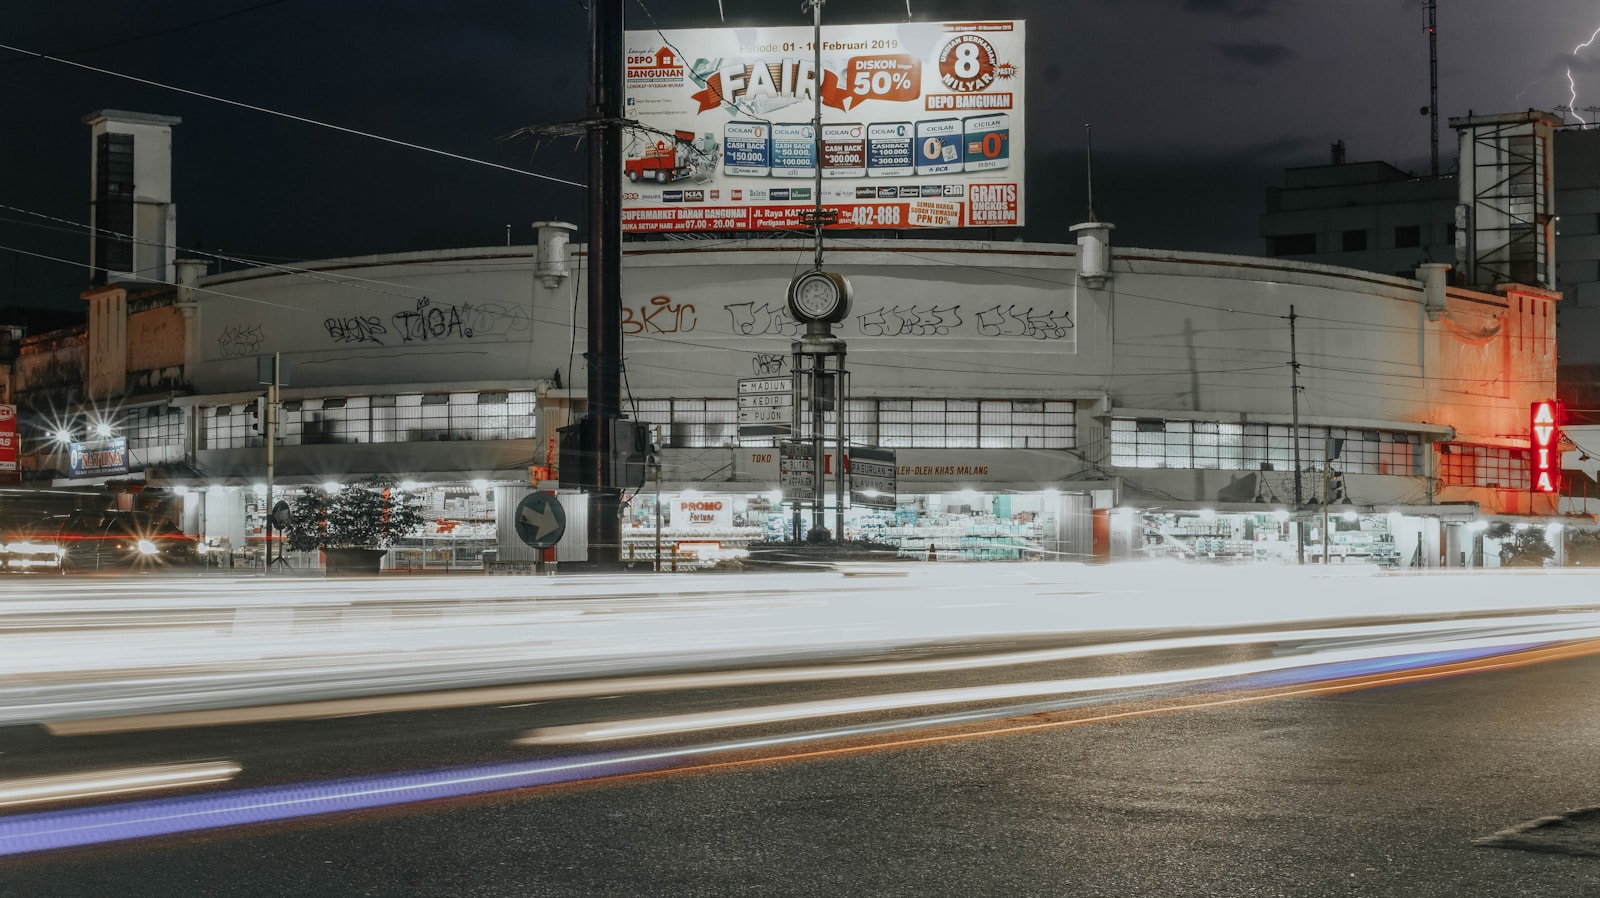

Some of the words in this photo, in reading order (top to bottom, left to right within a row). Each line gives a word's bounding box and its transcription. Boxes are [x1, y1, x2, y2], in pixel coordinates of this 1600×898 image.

[783, 42, 795, 51] 01
[822, 40, 868, 51] Februari
[872, 39, 898, 49] 2019
[627, 56, 653, 64] DEPO
[856, 60, 897, 70] DISKON
[955, 42, 981, 79] 8
[627, 69, 684, 78] BANGUNAN
[719, 57, 825, 107] FAIR
[853, 71, 911, 96] 50%
[943, 73, 993, 92] MILYAR
[928, 96, 954, 109] DEPO
[955, 94, 1010, 109] BANGUNAN
[973, 120, 1001, 128] CICILAN
[727, 142, 746, 150] CASH
[970, 185, 1016, 203] GRATIS
[916, 201, 934, 209] SEMUA
[935, 203, 954, 211] HARGA
[972, 202, 1008, 211] ONGKOS
[622, 210, 676, 220] SUPERMARKET
[677, 209, 703, 219] BAHAN
[704, 208, 747, 219] BANGUNAN
[764, 210, 783, 219] Raya
[851, 205, 901, 226] 482-888
[911, 207, 929, 215] SUDAH
[929, 209, 958, 217] TERMASUK
[972, 210, 1015, 221] KIRIM
[685, 220, 707, 229] 07.00
[713, 219, 735, 228] 20.00
[916, 214, 932, 223] PPN
[934, 215, 951, 225] 10%
[751, 381, 786, 391] MADIUN
[752, 396, 783, 406] KEDIRI
[755, 411, 781, 421] PUJON
[1534, 403, 1554, 491] AVIA
[752, 454, 772, 463] TOKO
[851, 463, 886, 475] PASURUAN
[896, 465, 933, 476] LEH-OLEH
[935, 465, 955, 475] KHAS
[956, 465, 988, 476] MALANG
[855, 479, 883, 490] LAWANG
[681, 501, 723, 511] PROMO
[689, 512, 715, 522] Fortune
